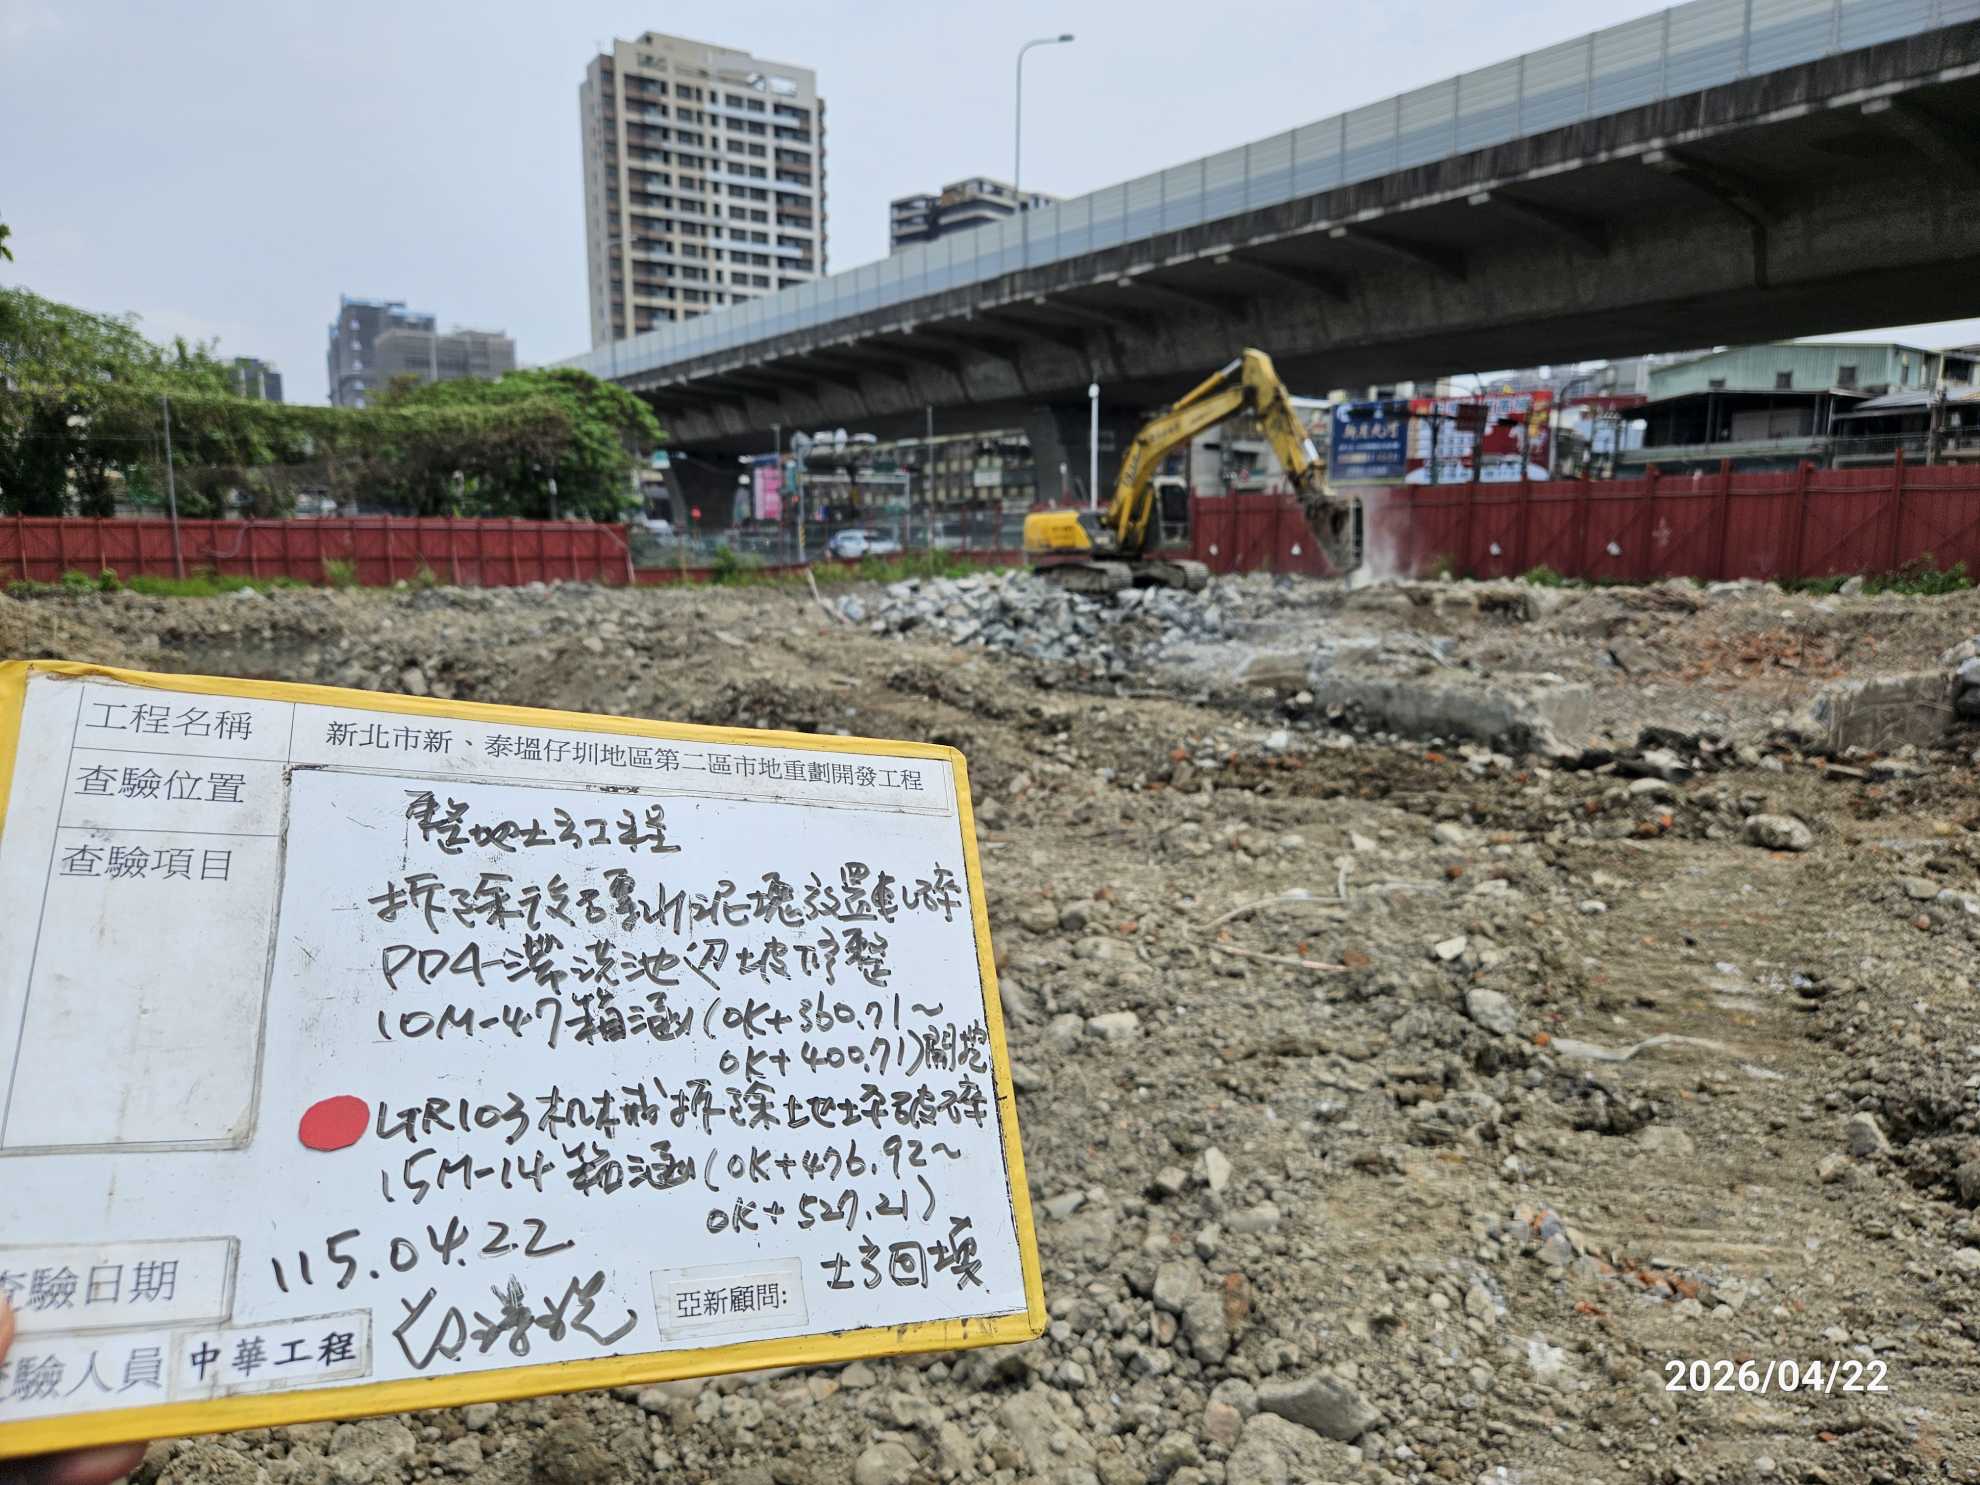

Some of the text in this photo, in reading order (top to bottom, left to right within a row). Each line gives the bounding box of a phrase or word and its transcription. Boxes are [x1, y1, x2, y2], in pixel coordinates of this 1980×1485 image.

[85, 702, 253, 741] 工程名稱
[326, 720, 924, 791] 新北市新、泰塭仔圳地區第二區市地重劃開發工程
[74, 764, 247, 804] 查驗位置
[58, 845, 233, 882] 查驗項目
[272, 1216, 576, 1292] 115.04.22
[676, 1283, 788, 1319] 亞新顧問:
[0, 1346, 163, 1401] 驗人員
[190, 1331, 357, 1381] 中華工程
